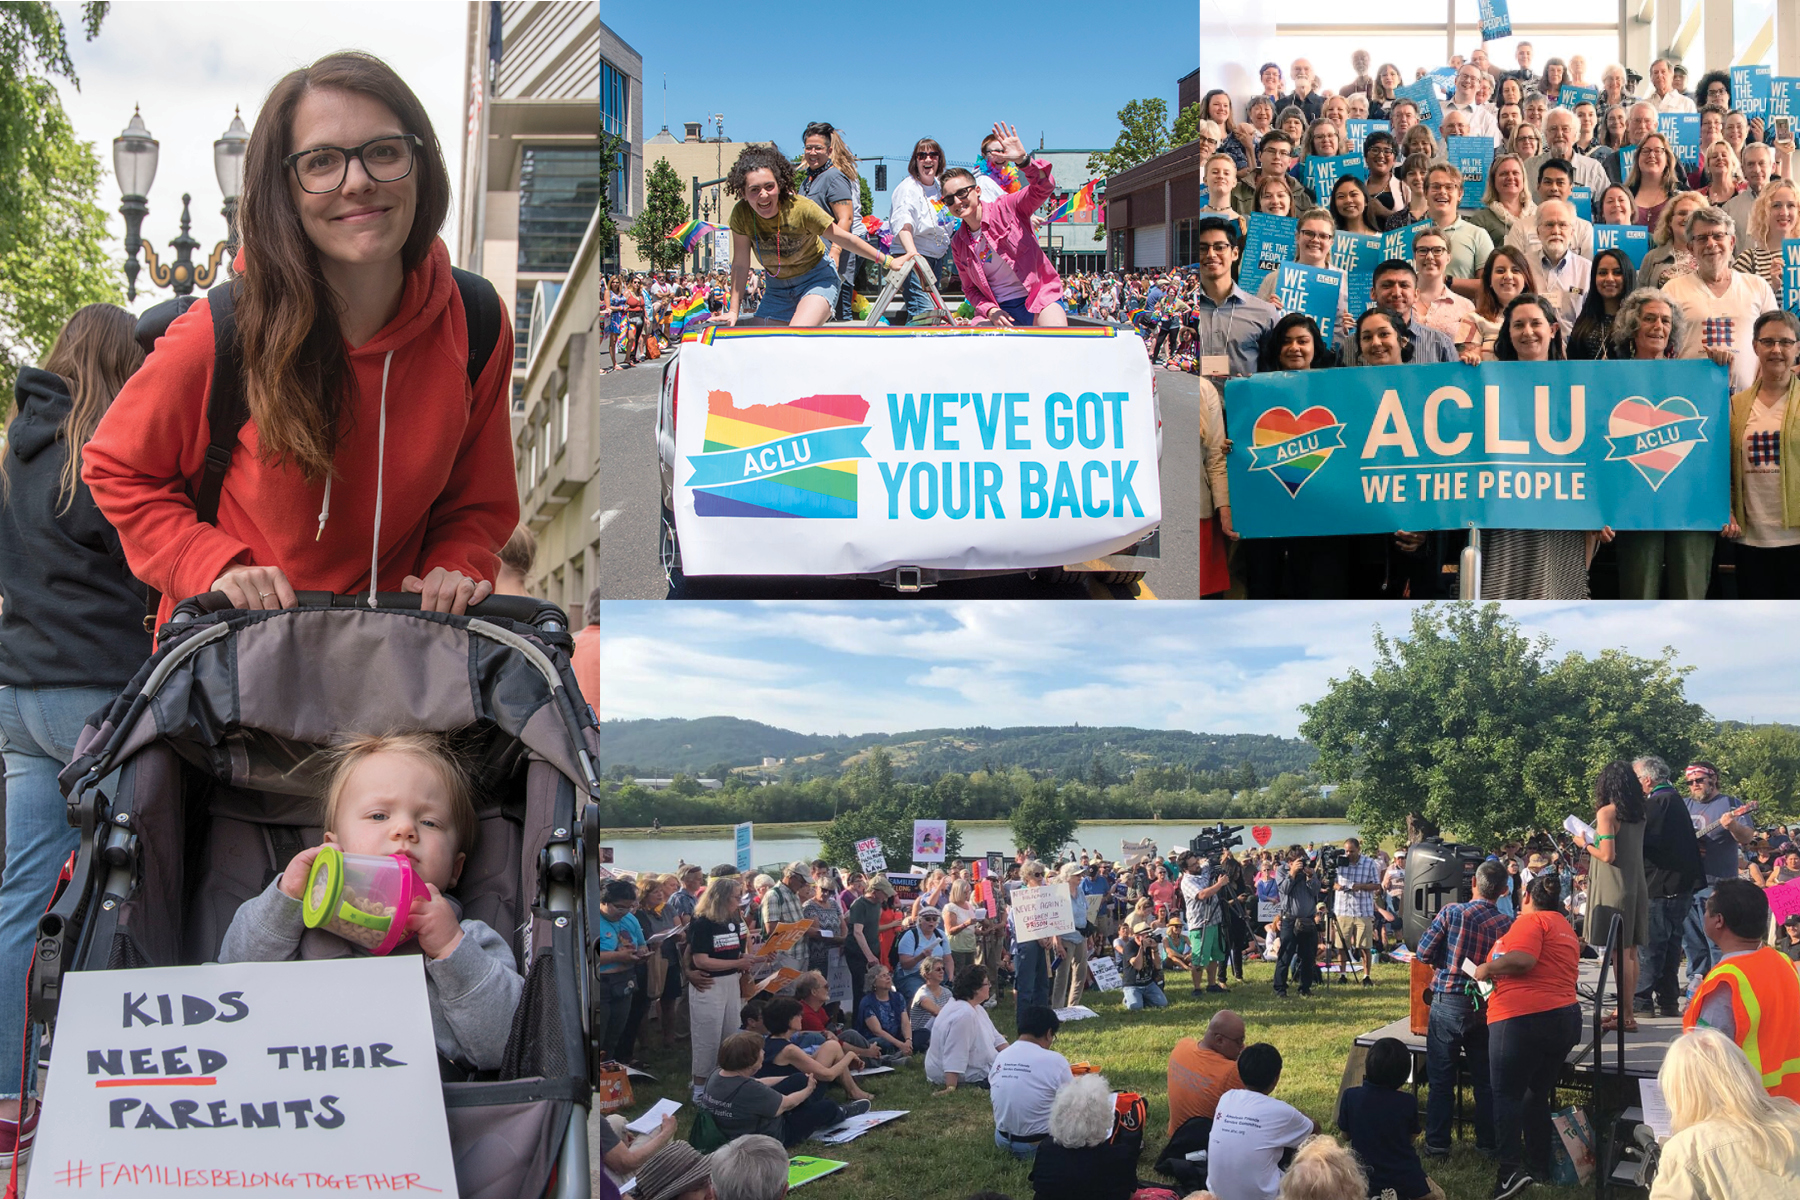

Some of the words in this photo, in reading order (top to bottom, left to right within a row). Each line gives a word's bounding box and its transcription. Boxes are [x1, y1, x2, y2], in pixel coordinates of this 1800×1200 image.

[1734, 69, 1750, 84] WE
[1562, 90, 1577, 105] WE
[1734, 84, 1753, 99] THE
[1771, 82, 1790, 98] WE
[1770, 98, 1791, 115] THE
[1350, 124, 1367, 138] WE
[1661, 116, 1678, 130] WE
[1351, 138, 1366, 153] TH
[1672, 144, 1698, 159] OPLE
[1623, 149, 1635, 165] W
[1317, 161, 1338, 178] WE
[1337, 235, 1358, 255] WE
[1385, 230, 1406, 248] WE
[1597, 229, 1619, 248] WE
[1260, 250, 1287, 262] PEOPLE
[1262, 241, 1273, 252] WE
[1275, 243, 1289, 254] THE
[1383, 243, 1407, 260] THE
[1787, 245, 1800, 265] W
[1284, 267, 1308, 290] WE
[1319, 275, 1338, 285] ACLU
[1281, 287, 1309, 313] THE
[886, 392, 1031, 451] WE'VE
[1044, 391, 1129, 451] GOT
[1360, 385, 1587, 459] ACLU
[1635, 425, 1680, 452] ACLU
[1276, 434, 1319, 462] ACLU
[742, 438, 812, 477] ACLU
[877, 460, 1006, 520] YOUR
[1019, 460, 1145, 520] BACK
[1361, 475, 1406, 503] WE
[1416, 471, 1468, 502] THE
[1478, 470, 1586, 500] PEOPLE
[858, 839, 876, 852] LOVE
[866, 865, 883, 873] LAW
[1015, 903, 1037, 915] NEVER
[1026, 920, 1048, 929] PRISON
[122, 991, 249, 1029] KIDS
[87, 1046, 228, 1076] NEED
[267, 1043, 408, 1071] THEIR
[109, 1095, 346, 1130] PARENTS
